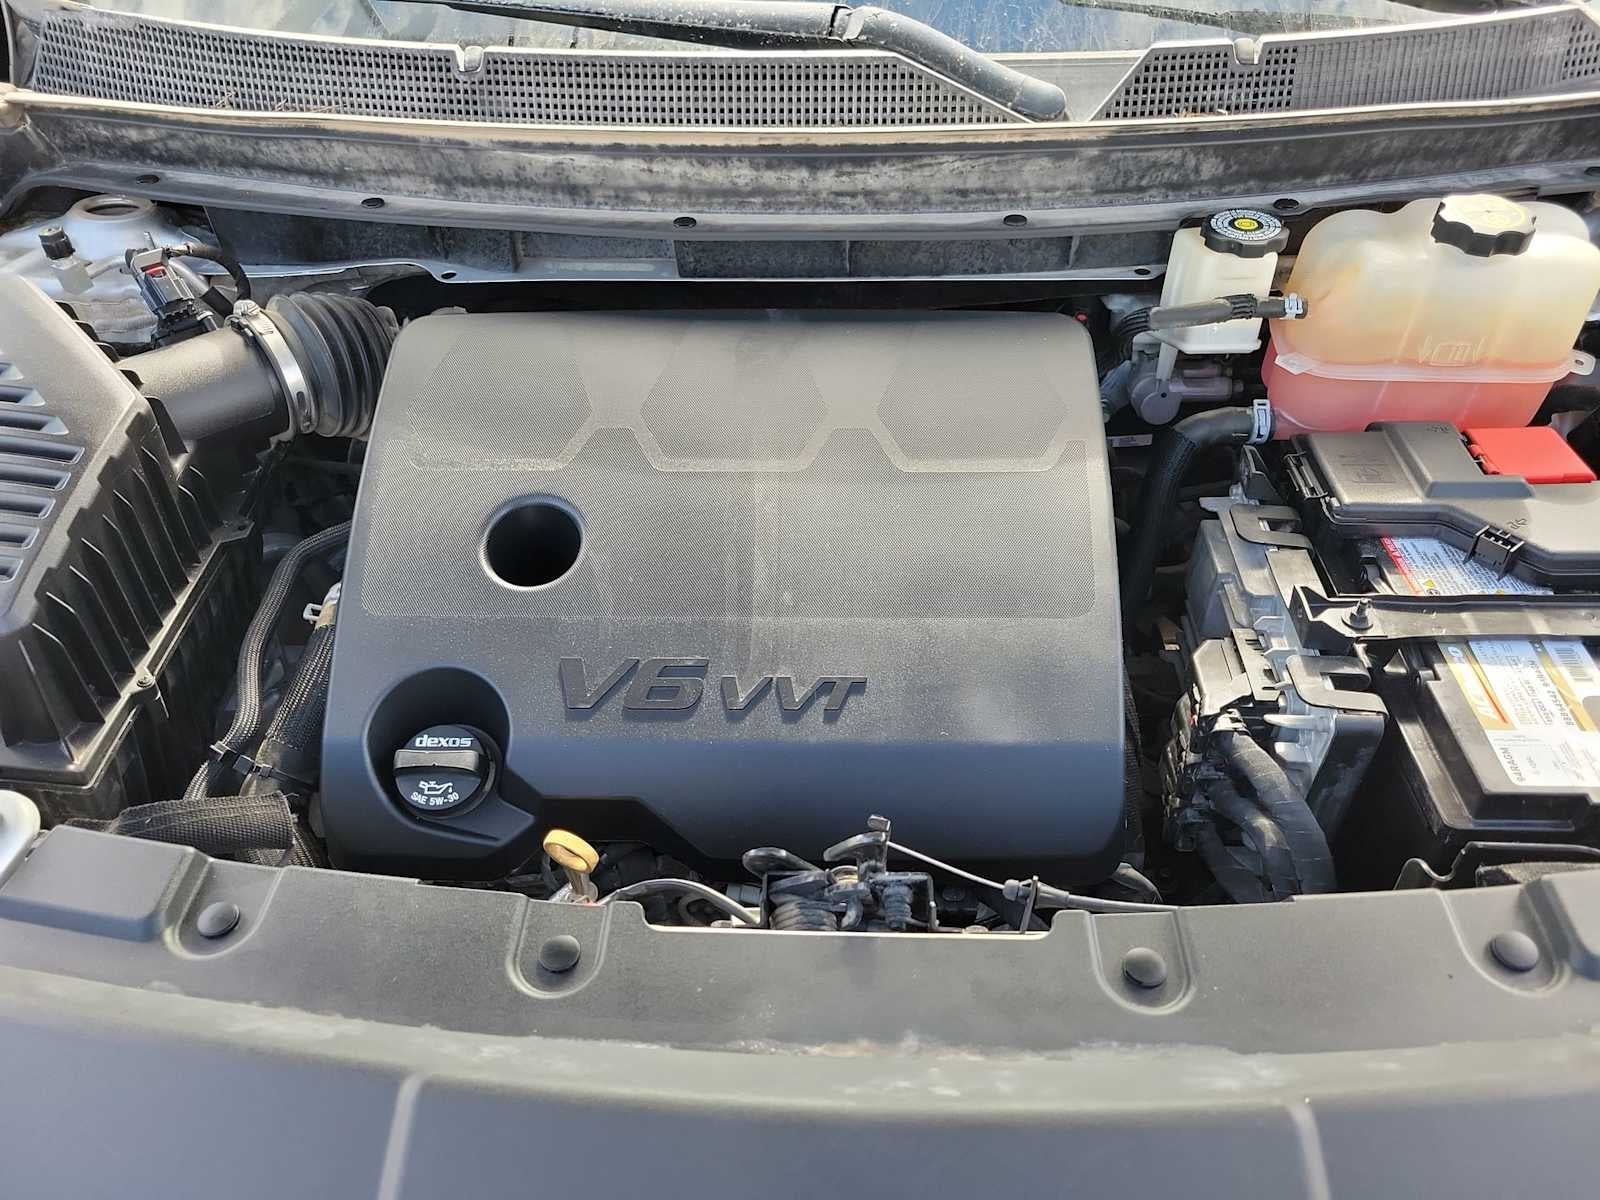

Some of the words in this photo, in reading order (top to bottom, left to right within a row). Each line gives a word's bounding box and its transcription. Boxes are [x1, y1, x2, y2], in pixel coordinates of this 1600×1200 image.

[559, 656, 710, 711] V6
[720, 675, 868, 712] VVT
[415, 734, 474, 749] dexos
[410, 791, 429, 805] SAE
[429, 791, 460, 806] 5W-30
